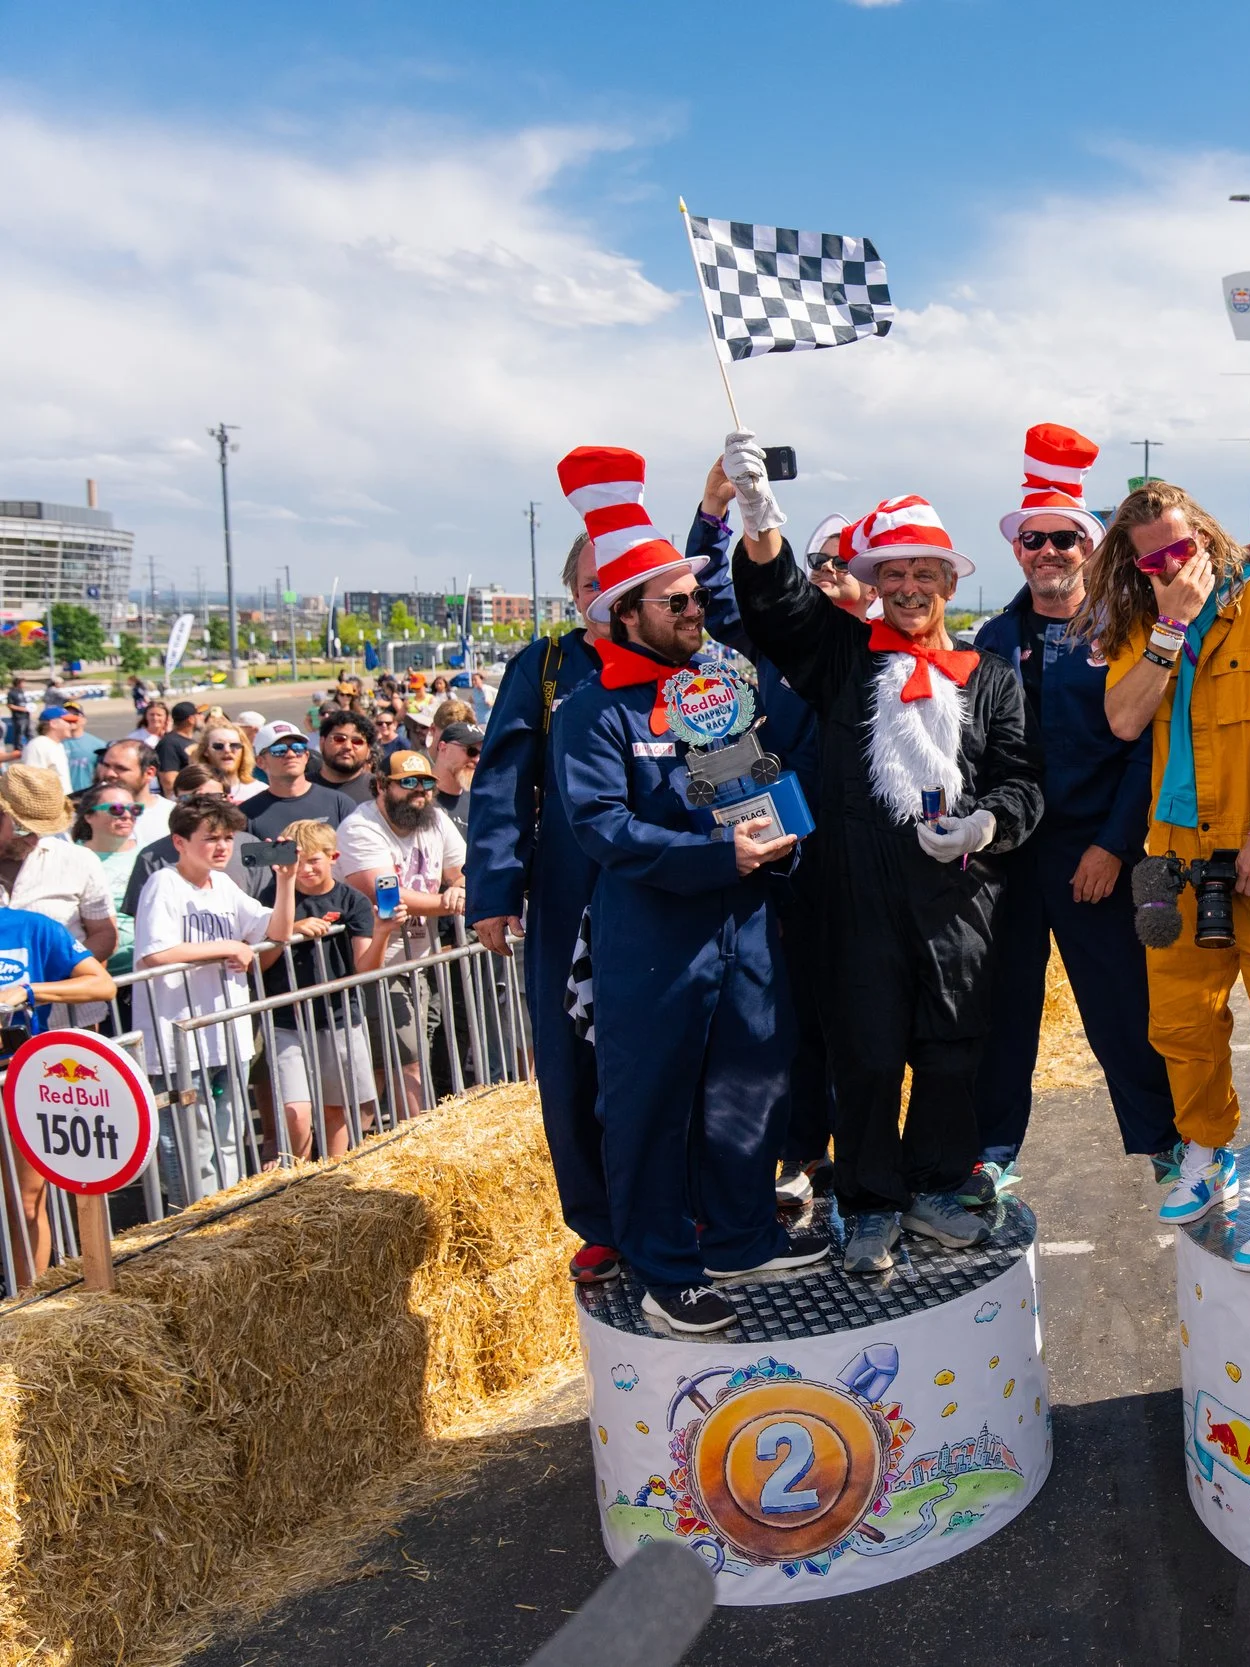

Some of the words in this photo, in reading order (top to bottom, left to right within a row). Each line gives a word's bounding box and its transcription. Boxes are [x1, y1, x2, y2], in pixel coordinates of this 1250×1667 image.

[680, 698, 708, 717] Red
[708, 687, 736, 708] Bull
[692, 703, 734, 724] SOAPBOX
[706, 717, 728, 732] RACE
[740, 808, 768, 822] PLACE
[38, 1083, 72, 1106] Red
[73, 1086, 111, 1109] Bull
[755, 1420, 821, 1515] 2
